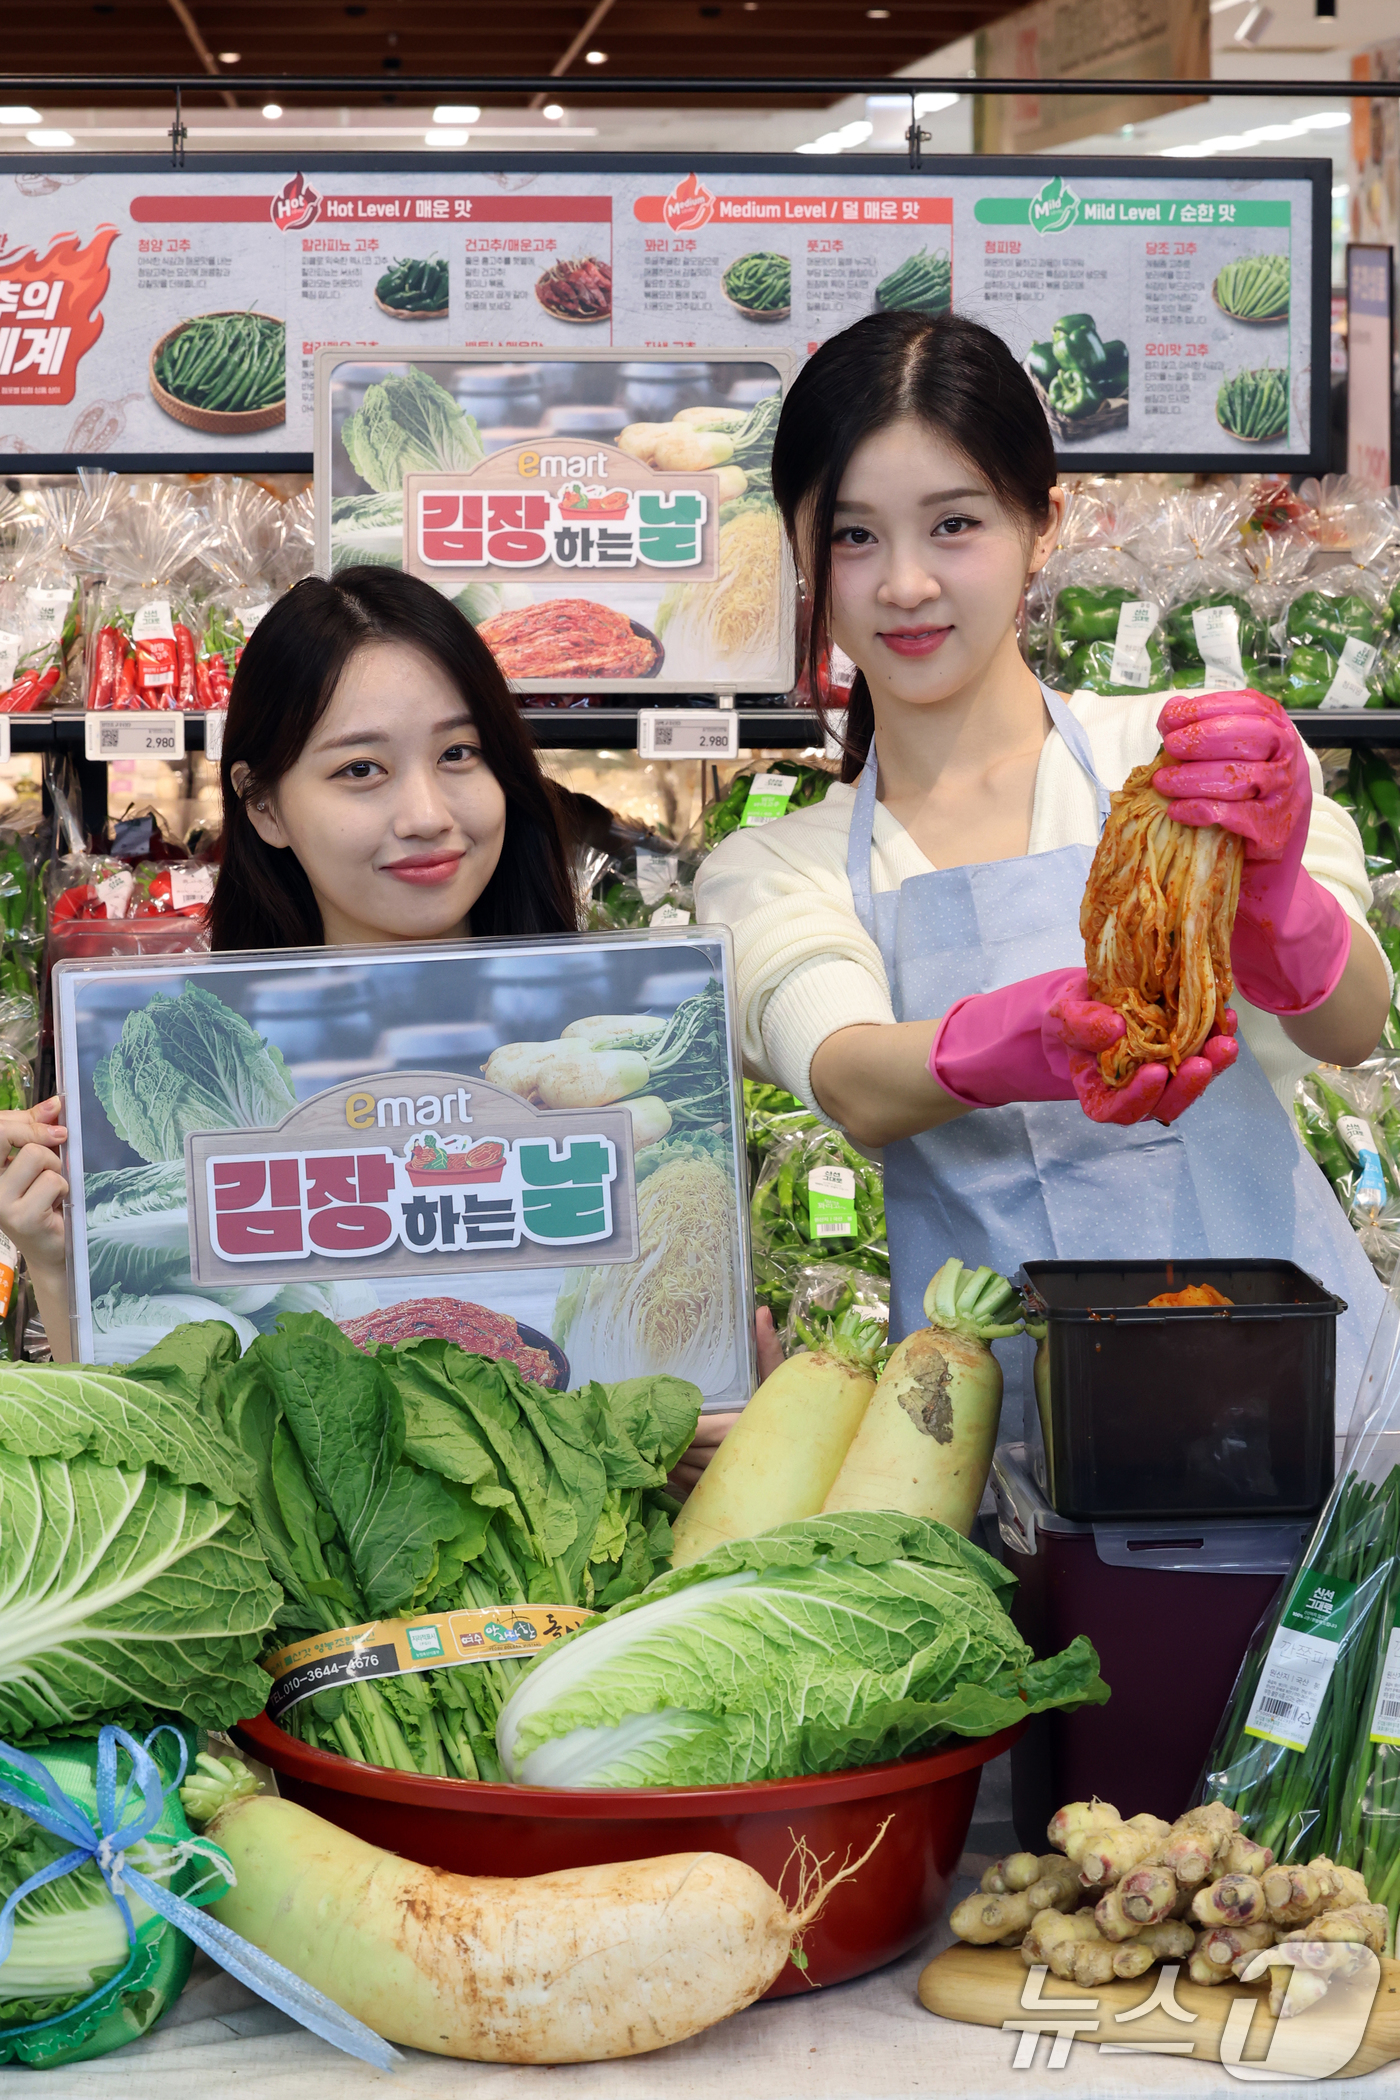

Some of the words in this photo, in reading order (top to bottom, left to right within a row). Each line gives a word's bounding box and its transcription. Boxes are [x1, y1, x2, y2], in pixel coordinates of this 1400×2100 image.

[276, 194, 305, 218] Hot
[327, 200, 354, 218] Hot
[357, 200, 400, 218] Level
[415, 200, 450, 219] 매운
[454, 200, 473, 219] 맛
[667, 196, 706, 217] Medium
[719, 201, 781, 218] Medium
[785, 201, 827, 218] Level
[842, 201, 859, 220] 덜
[864, 201, 898, 220] 매운
[902, 201, 920, 220] 맛
[1034, 198, 1063, 219] Mild
[1084, 203, 1116, 221] Mild
[1119, 204, 1161, 222] Level
[1180, 204, 1215, 223] 순한
[1218, 205, 1237, 223] 맛
[138, 239, 164, 253] 청양
[166, 239, 191, 253] 고추
[302, 238, 351, 252] 할라피뇨
[355, 238, 380, 252] 고추
[465, 238, 557, 253] 건고추/매운고추
[644, 239, 669, 253] 꽈리
[672, 239, 698, 253] 고추
[807, 239, 844, 253] 풋고추
[985, 240, 1022, 254] 청피망
[1146, 242, 1170, 256] 당조
[1174, 242, 1198, 256] 고추
[1145, 343, 1182, 357] 오이맛
[1185, 343, 1210, 357] 고추
[518, 451, 608, 478] emart
[345, 1087, 473, 1130] emart
[1312, 1587, 1336, 1603] 신선
[1305, 1598, 1334, 1614] 그대로
[461, 1634, 483, 1644] 여수
[1280, 1640, 1329, 1669] 깐쪽파
[1269, 1668, 1290, 1680] 원산지
[1295, 1676, 1310, 1687] 국산
